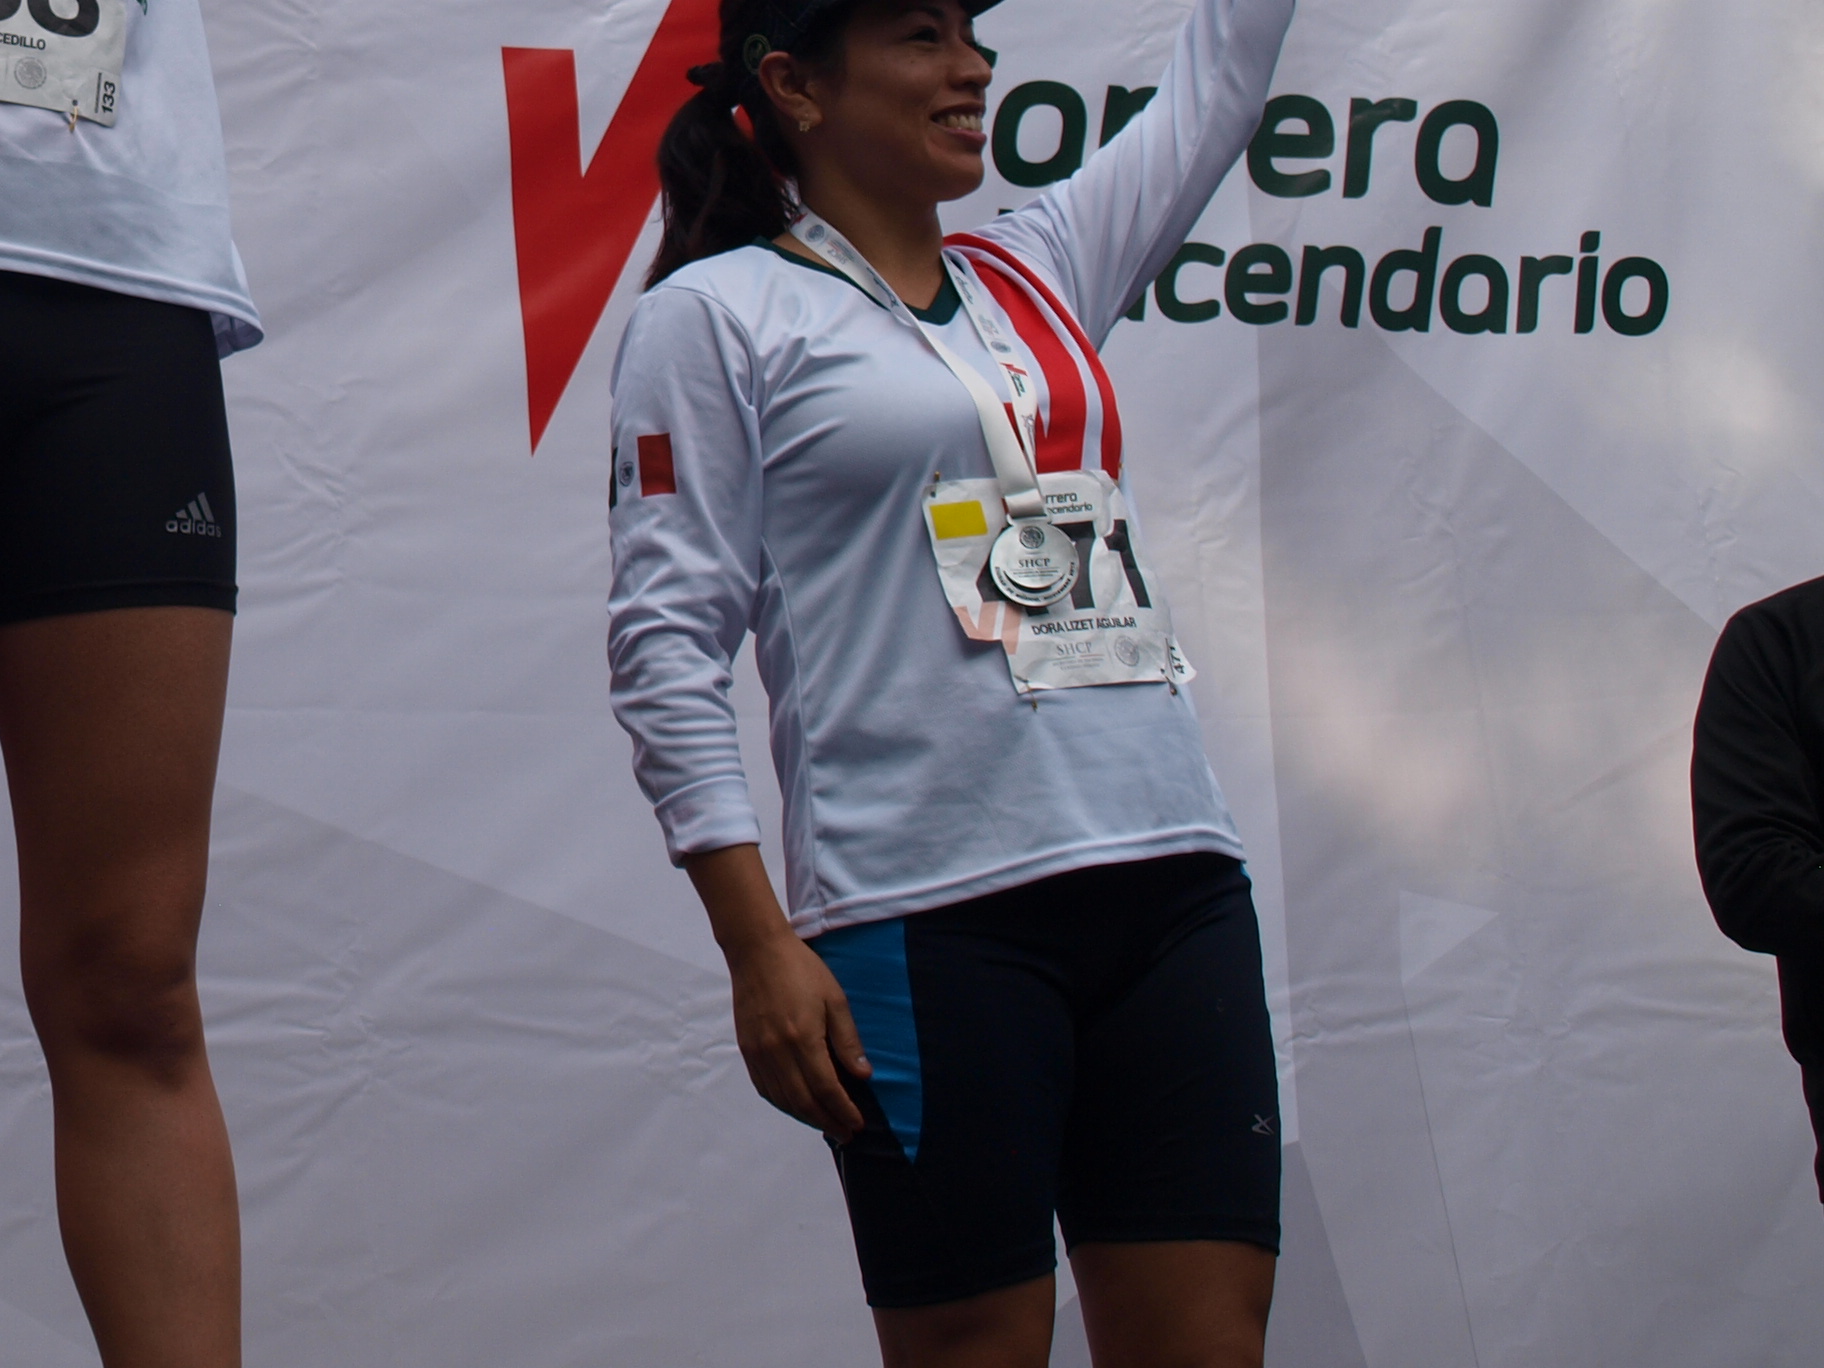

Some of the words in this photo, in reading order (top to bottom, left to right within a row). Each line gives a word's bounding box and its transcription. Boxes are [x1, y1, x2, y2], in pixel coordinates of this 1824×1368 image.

[101, 81, 116, 113] 133
[1119, 225, 1670, 338] cendario
[1045, 492, 1078, 504] rrera
[165, 518, 222, 538] adidas
[1031, 621, 1065, 636] DORA
[1066, 618, 1094, 632] LIZET
[1096, 616, 1137, 630] AGUILAR
[1056, 641, 1093, 657] SHCP
